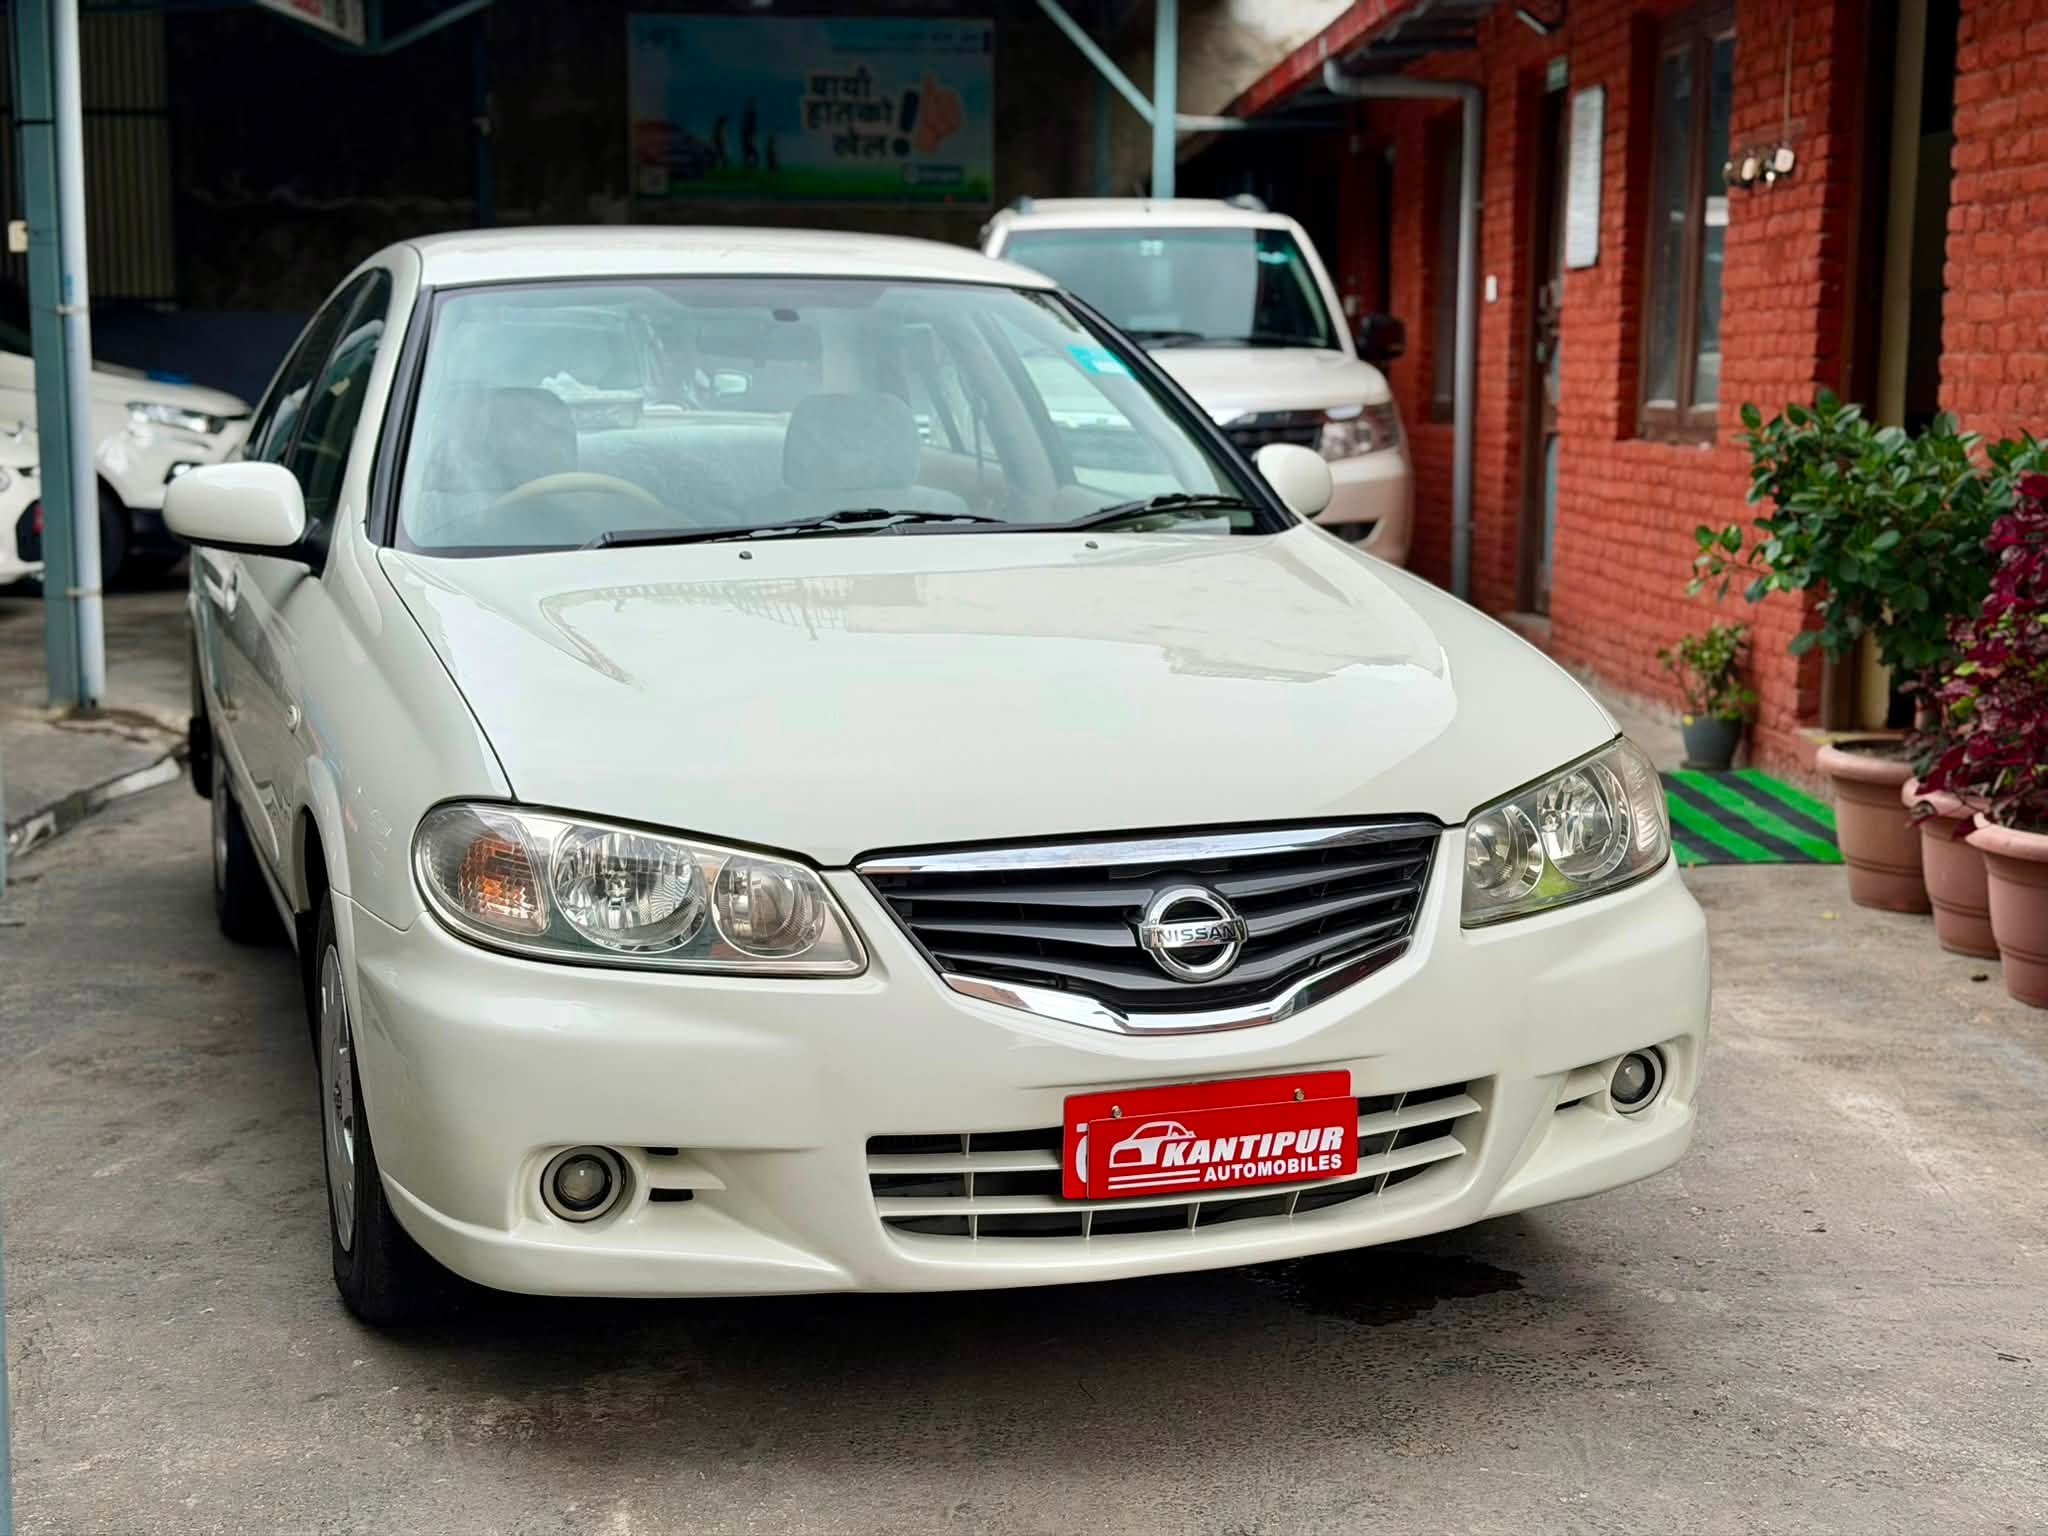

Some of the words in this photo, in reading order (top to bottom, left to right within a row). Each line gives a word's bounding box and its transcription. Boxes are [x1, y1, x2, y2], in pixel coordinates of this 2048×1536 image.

[1158, 924, 1235, 943] NISSAN
[1161, 1126, 1344, 1168] KANTIPUR
[1204, 1154, 1343, 1182] AUTOMOBILES
